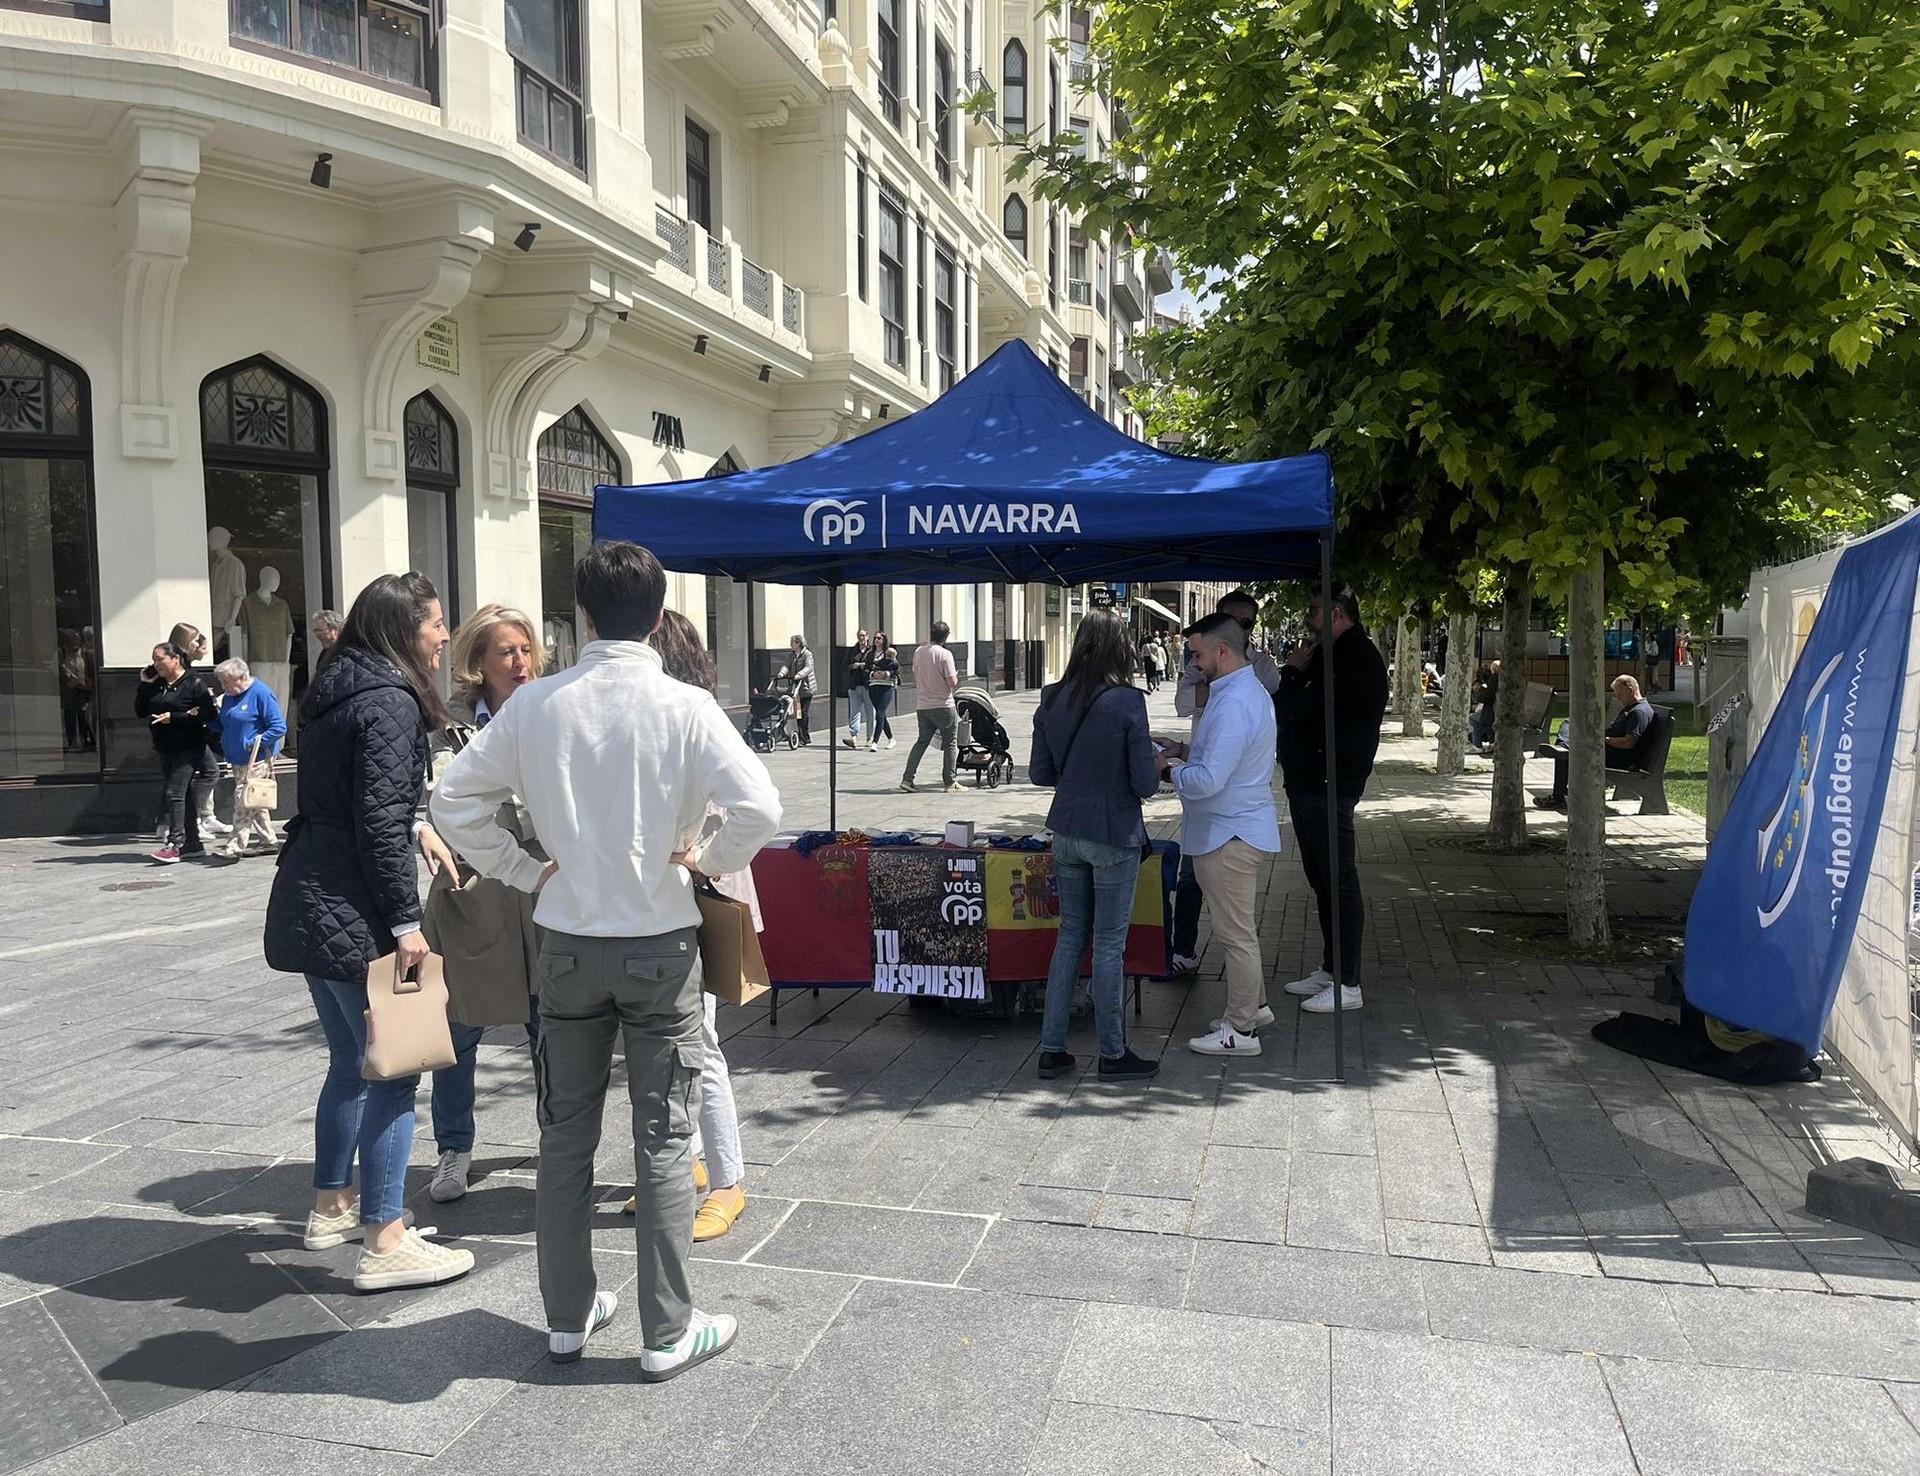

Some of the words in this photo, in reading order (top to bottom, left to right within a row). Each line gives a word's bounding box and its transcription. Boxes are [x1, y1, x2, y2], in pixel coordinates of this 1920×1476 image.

[652, 411, 686, 449] ZARA
[908, 503, 1081, 534] NAVARRA
[1825, 648, 1867, 929] www.eppgroup.
[954, 859, 977, 872] JUNIO
[943, 879, 982, 894] vota
[874, 929, 900, 964] TU
[873, 963, 986, 1000] RESPUESTA
